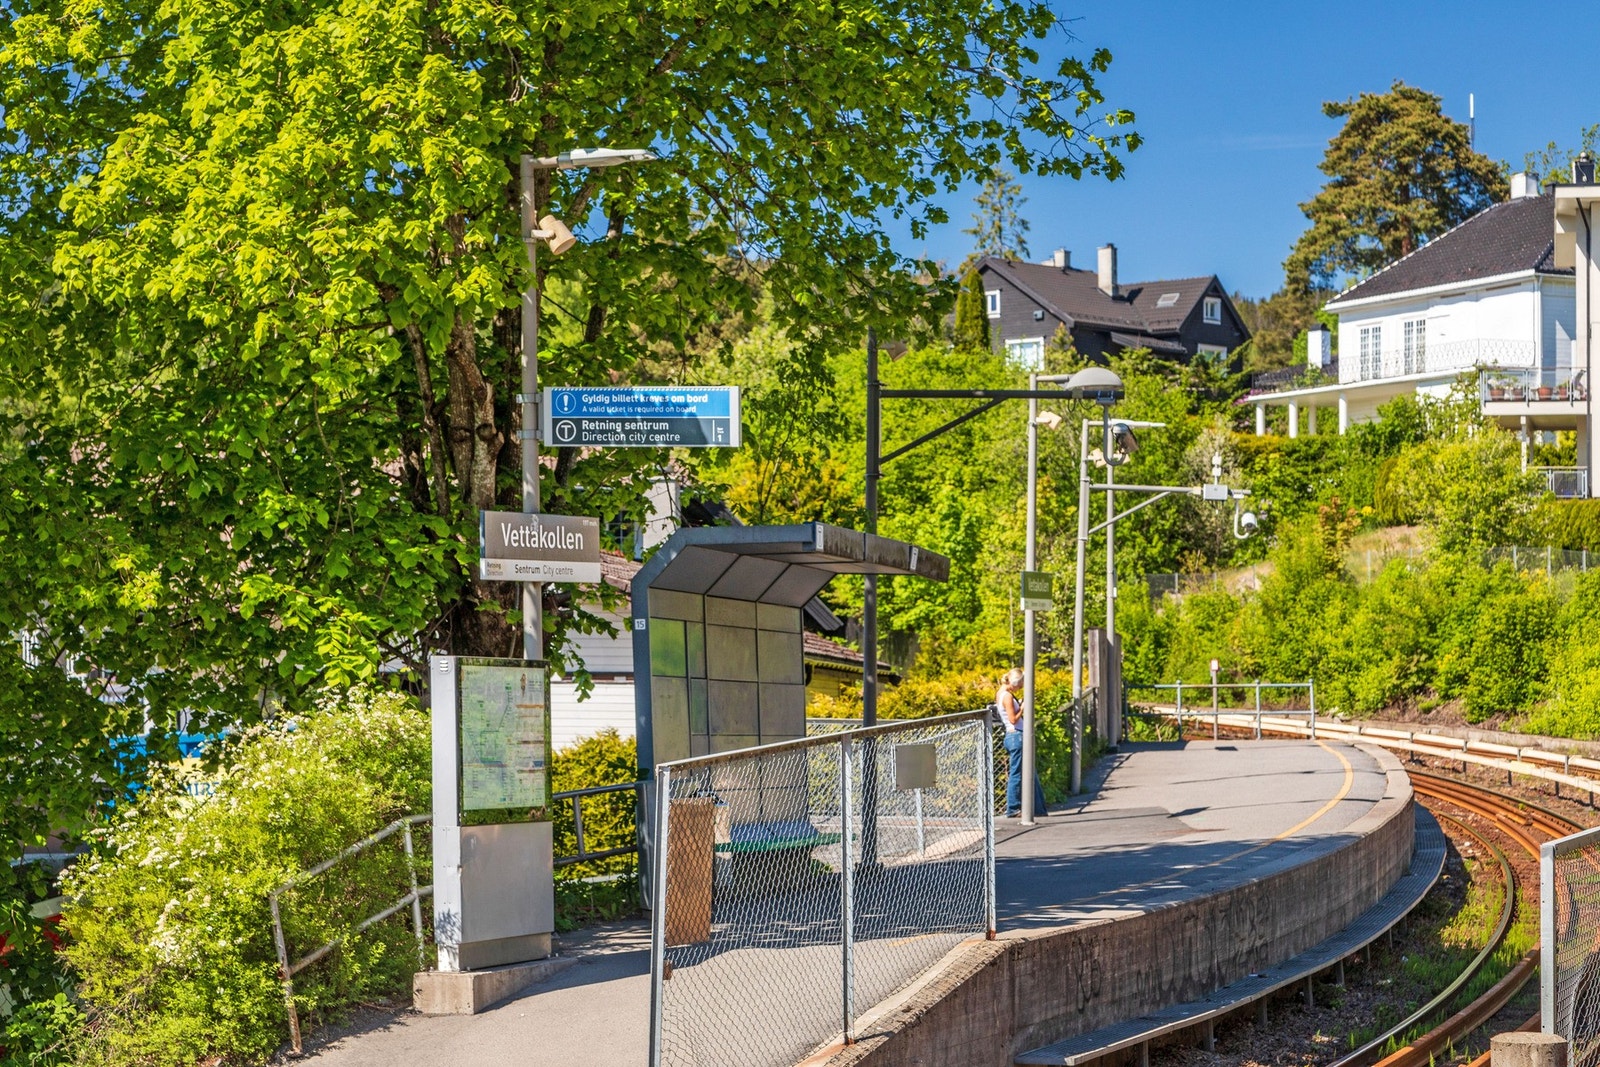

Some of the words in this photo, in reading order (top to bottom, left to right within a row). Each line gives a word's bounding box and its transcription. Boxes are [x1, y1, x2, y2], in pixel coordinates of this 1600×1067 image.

[581, 394, 610, 404] Gyldig
[612, 394, 638, 403] billett
[671, 395, 685, 403] om
[686, 394, 709, 403] bord
[634, 406, 664, 414] required
[582, 420, 622, 432] Retning
[624, 421, 669, 430] sentrum
[582, 432, 626, 442] Direction
[629, 432, 647, 443] city
[649, 433, 681, 442] centre
[501, 522, 584, 550] Vettakollen
[514, 564, 540, 574] Sentrum
[542, 564, 555, 577] City
[555, 567, 574, 576] centre
